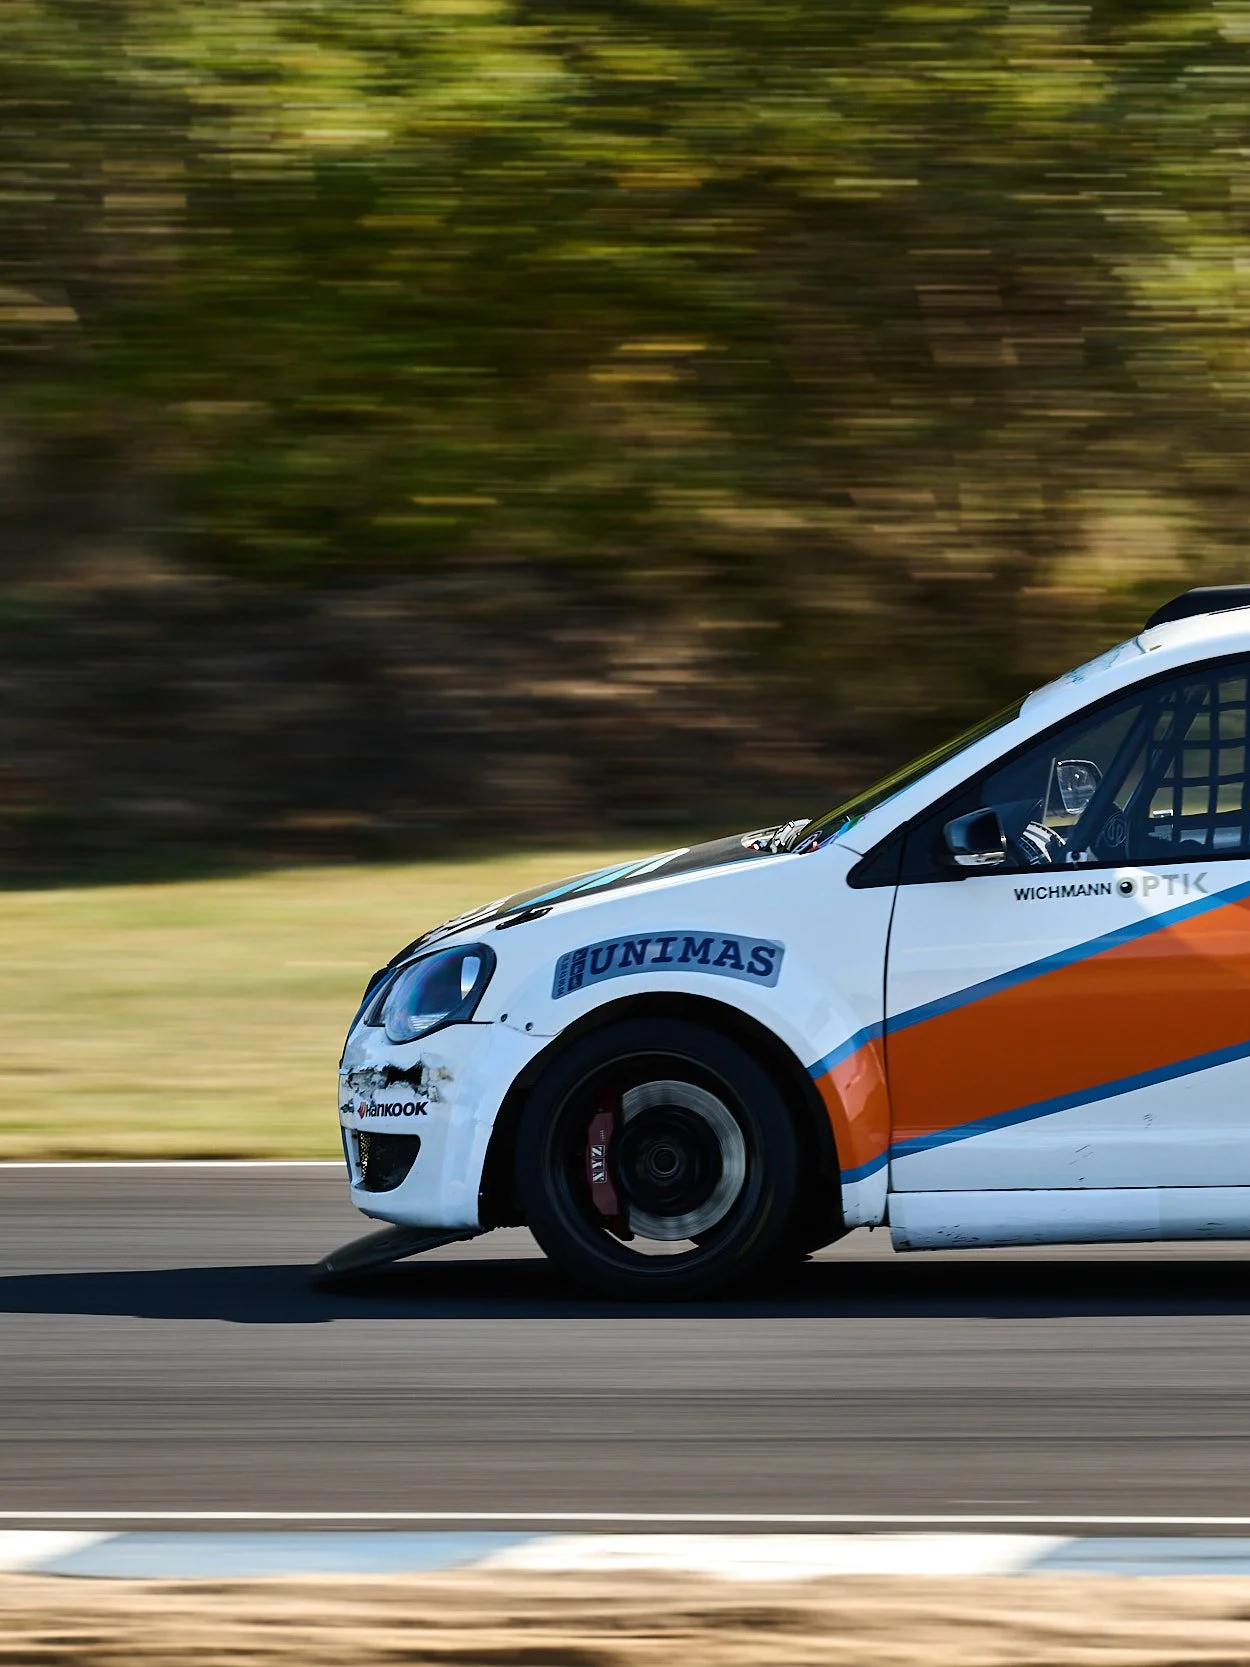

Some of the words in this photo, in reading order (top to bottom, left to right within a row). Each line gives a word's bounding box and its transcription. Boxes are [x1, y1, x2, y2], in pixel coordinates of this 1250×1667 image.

[1014, 882, 1112, 901] WICHMANN
[589, 936, 776, 977] UNIMAS
[591, 1145, 607, 1183] XYZ
